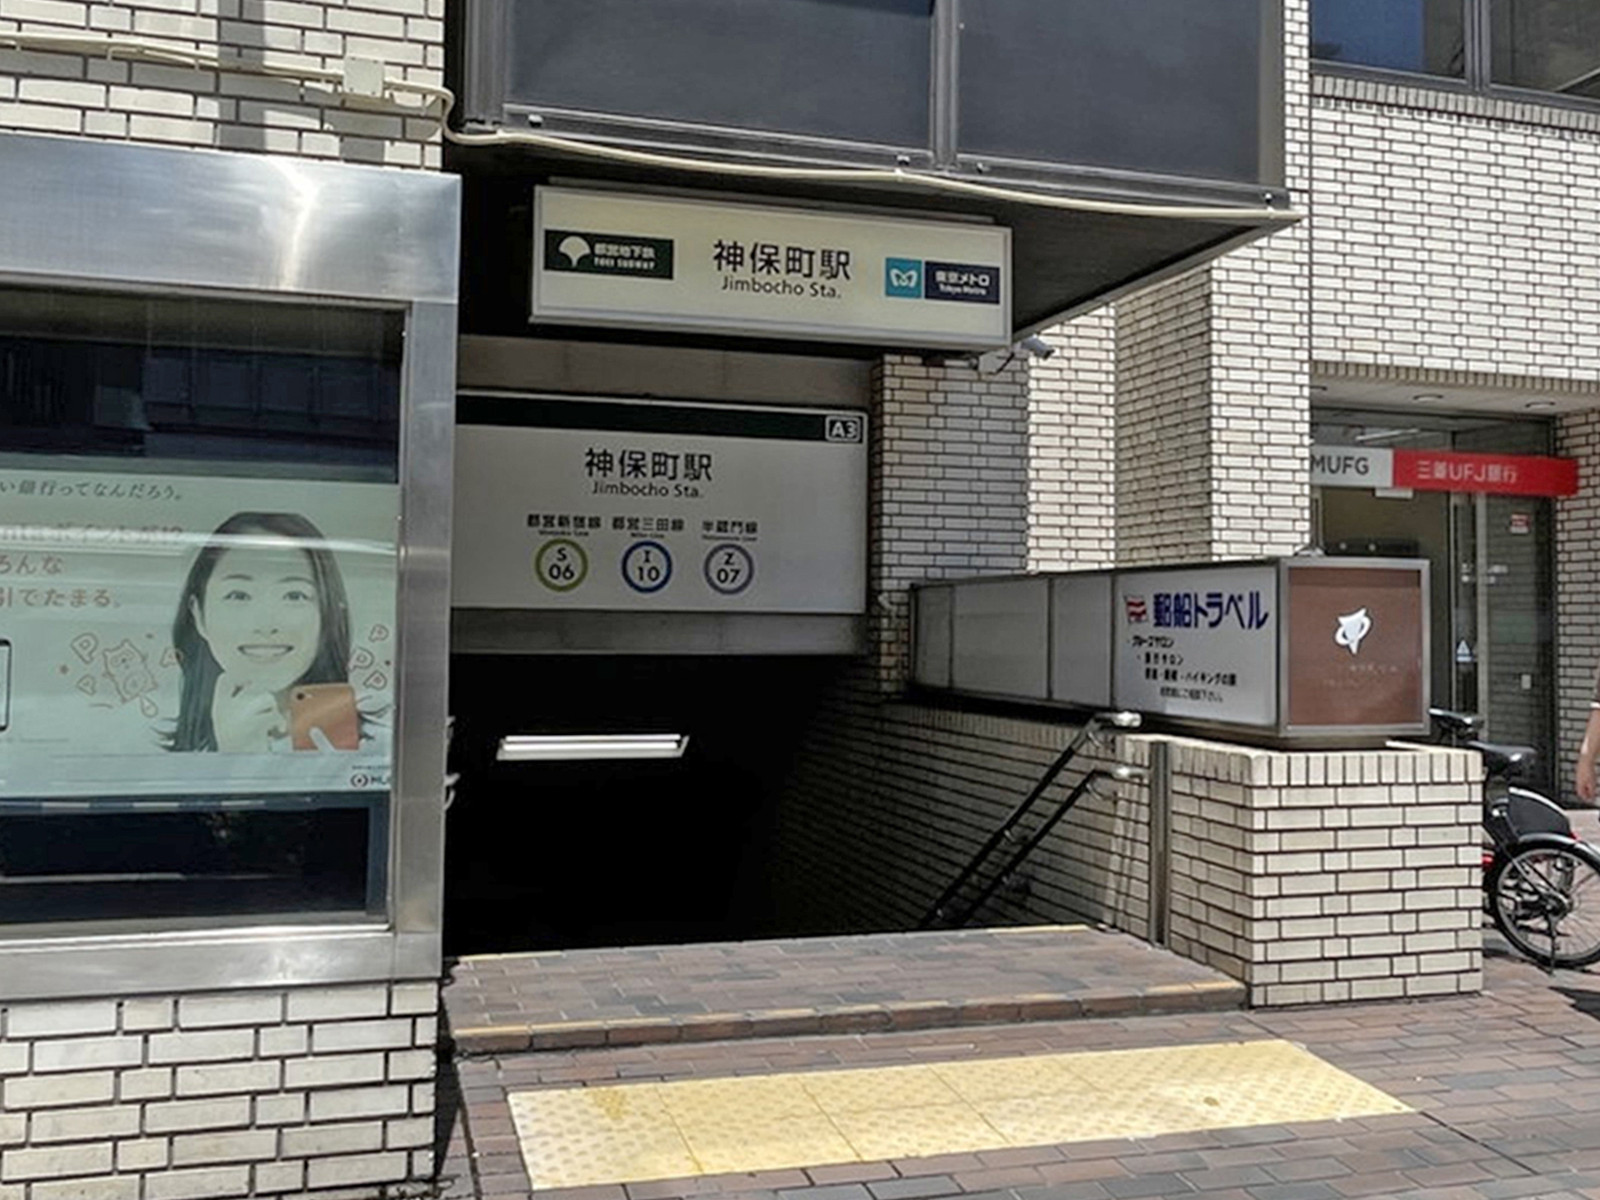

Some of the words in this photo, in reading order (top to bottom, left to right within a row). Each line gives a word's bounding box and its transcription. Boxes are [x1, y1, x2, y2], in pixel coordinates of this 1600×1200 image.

[713, 238, 850, 280] 神保町駅
[722, 275, 804, 296] Jimbocho
[809, 281, 842, 299] Sta.
[831, 421, 857, 438] A3
[585, 447, 712, 481] 神保町駅
[1310, 454, 1369, 476] MUFG
[592, 481, 669, 497] Jimbocho
[674, 483, 704, 498] Sta.
[555, 547, 568, 562] S
[642, 550, 652, 563] I
[723, 552, 735, 566] Z
[548, 563, 575, 580] 06
[638, 566, 661, 582] 10
[716, 568, 741, 584] 07
